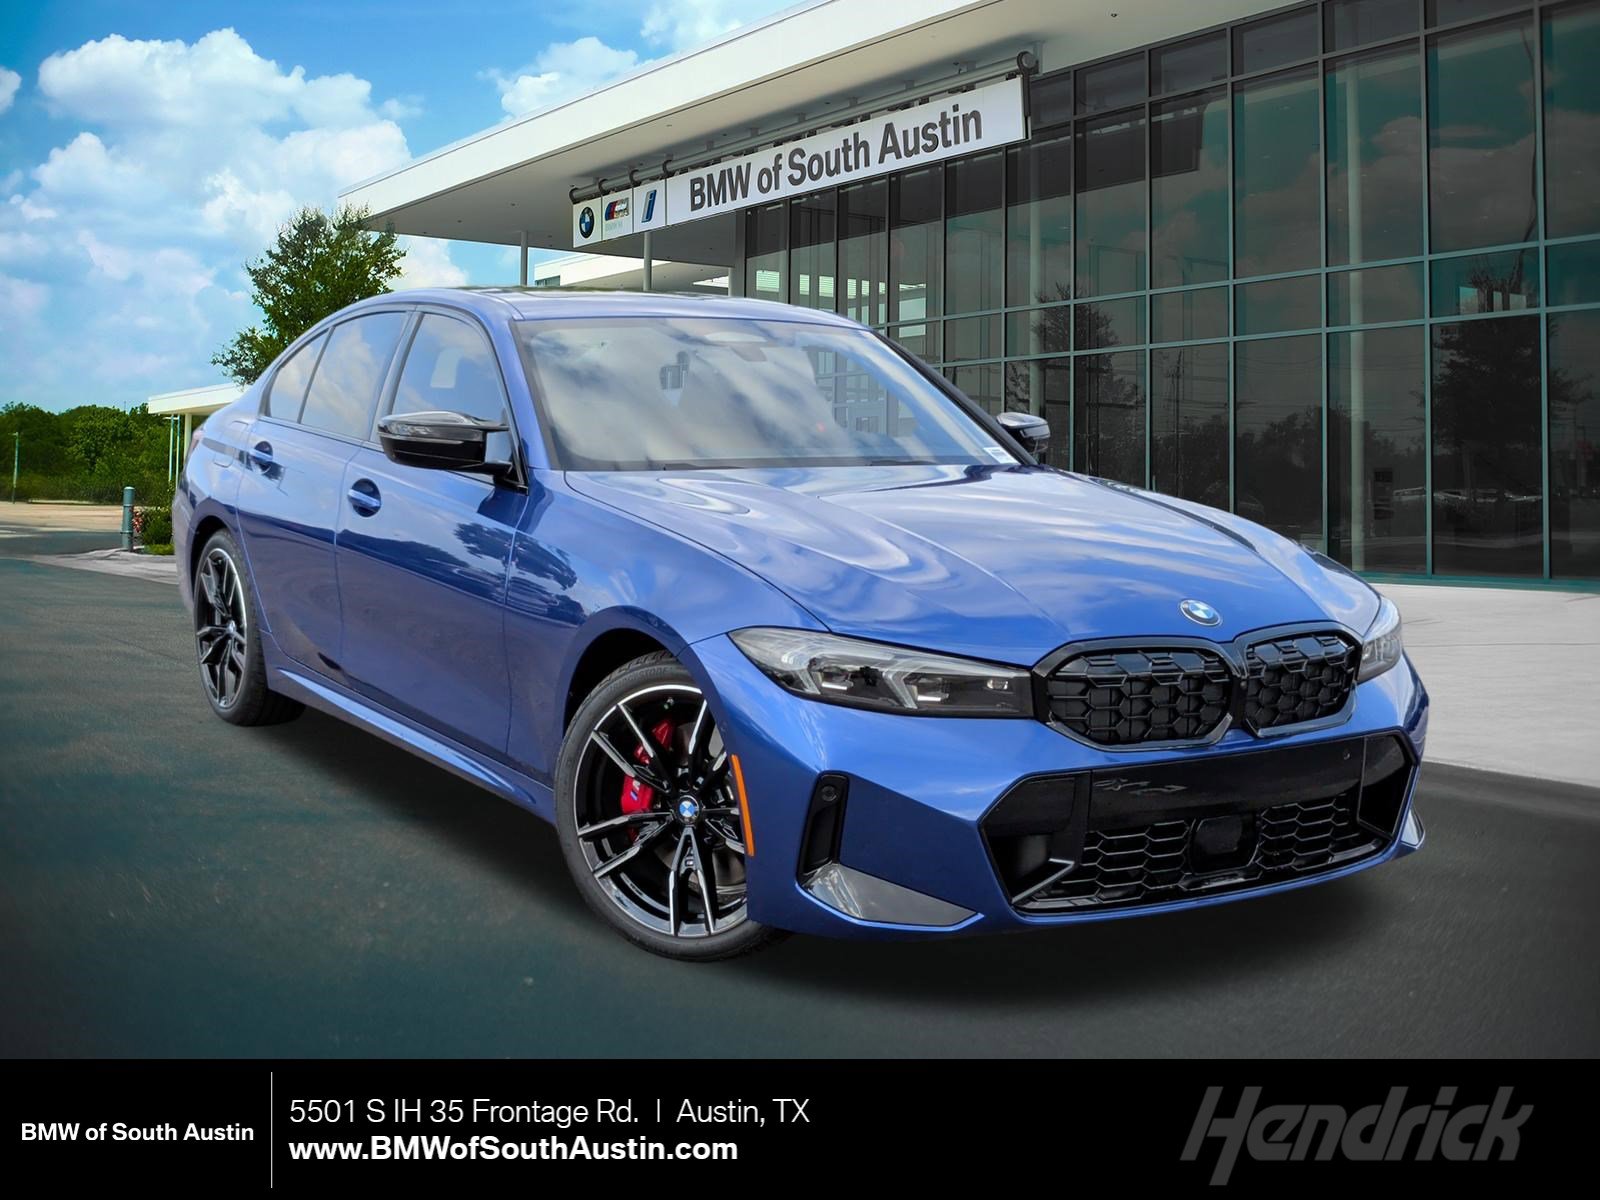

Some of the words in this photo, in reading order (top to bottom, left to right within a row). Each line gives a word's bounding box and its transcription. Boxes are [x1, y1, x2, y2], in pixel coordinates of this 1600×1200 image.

[690, 162, 752, 212] BMW
[757, 153, 783, 194] of
[787, 131, 871, 187] South
[878, 103, 982, 164] Austin
